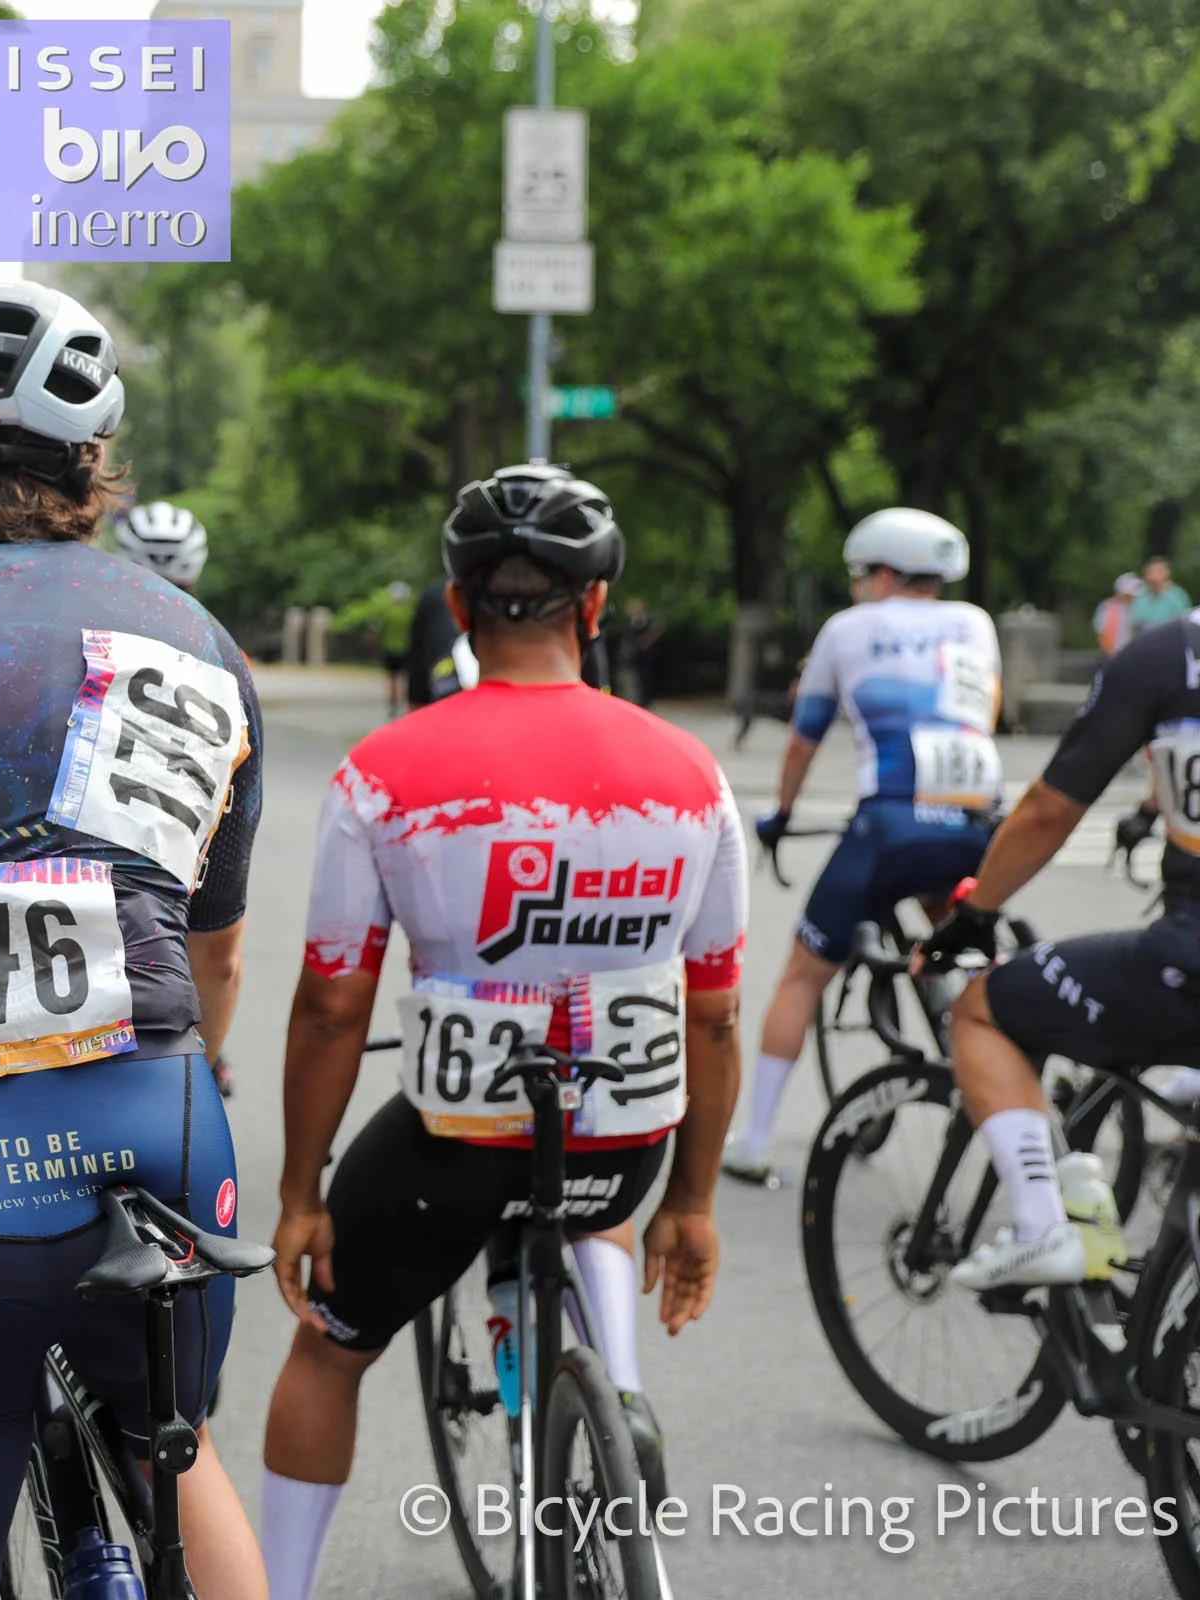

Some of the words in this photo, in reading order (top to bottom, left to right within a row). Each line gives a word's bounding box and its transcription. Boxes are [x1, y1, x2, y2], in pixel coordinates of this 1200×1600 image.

[109, 667, 232, 836] 176
[476, 841, 686, 946] Pedal
[477, 859, 672, 966] Power
[69, 1028, 132, 1057] inerro
[417, 1007, 526, 1103] 162
[608, 984, 681, 1106] 162
[46, 1130, 81, 1154] BE
[32, 1188, 71, 1210] york
